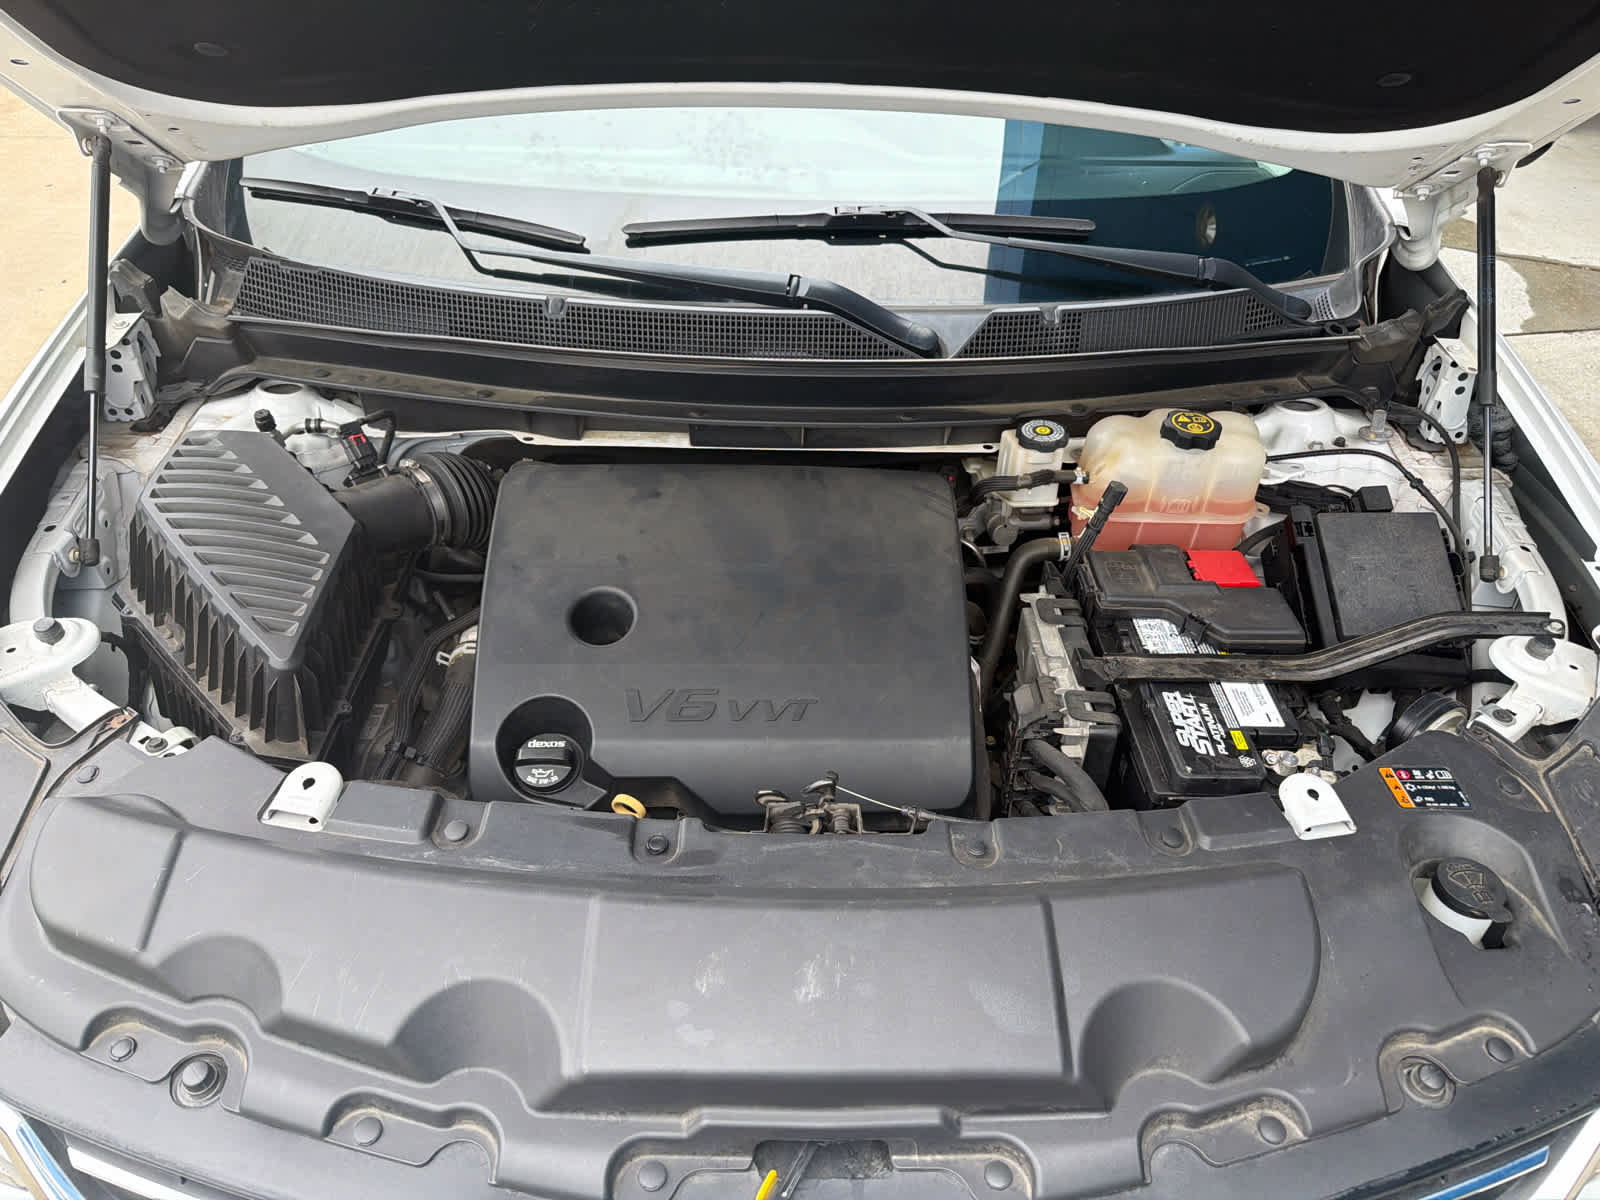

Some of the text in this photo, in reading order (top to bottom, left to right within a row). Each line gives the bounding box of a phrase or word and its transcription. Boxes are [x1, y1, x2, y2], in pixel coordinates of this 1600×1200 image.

[623, 688, 819, 722] V6 VVT
[1162, 691, 1191, 747] SUPER
[1177, 692, 1216, 757] START
[1199, 703, 1229, 755] PLATINUM
[527, 739, 568, 748] dexos
